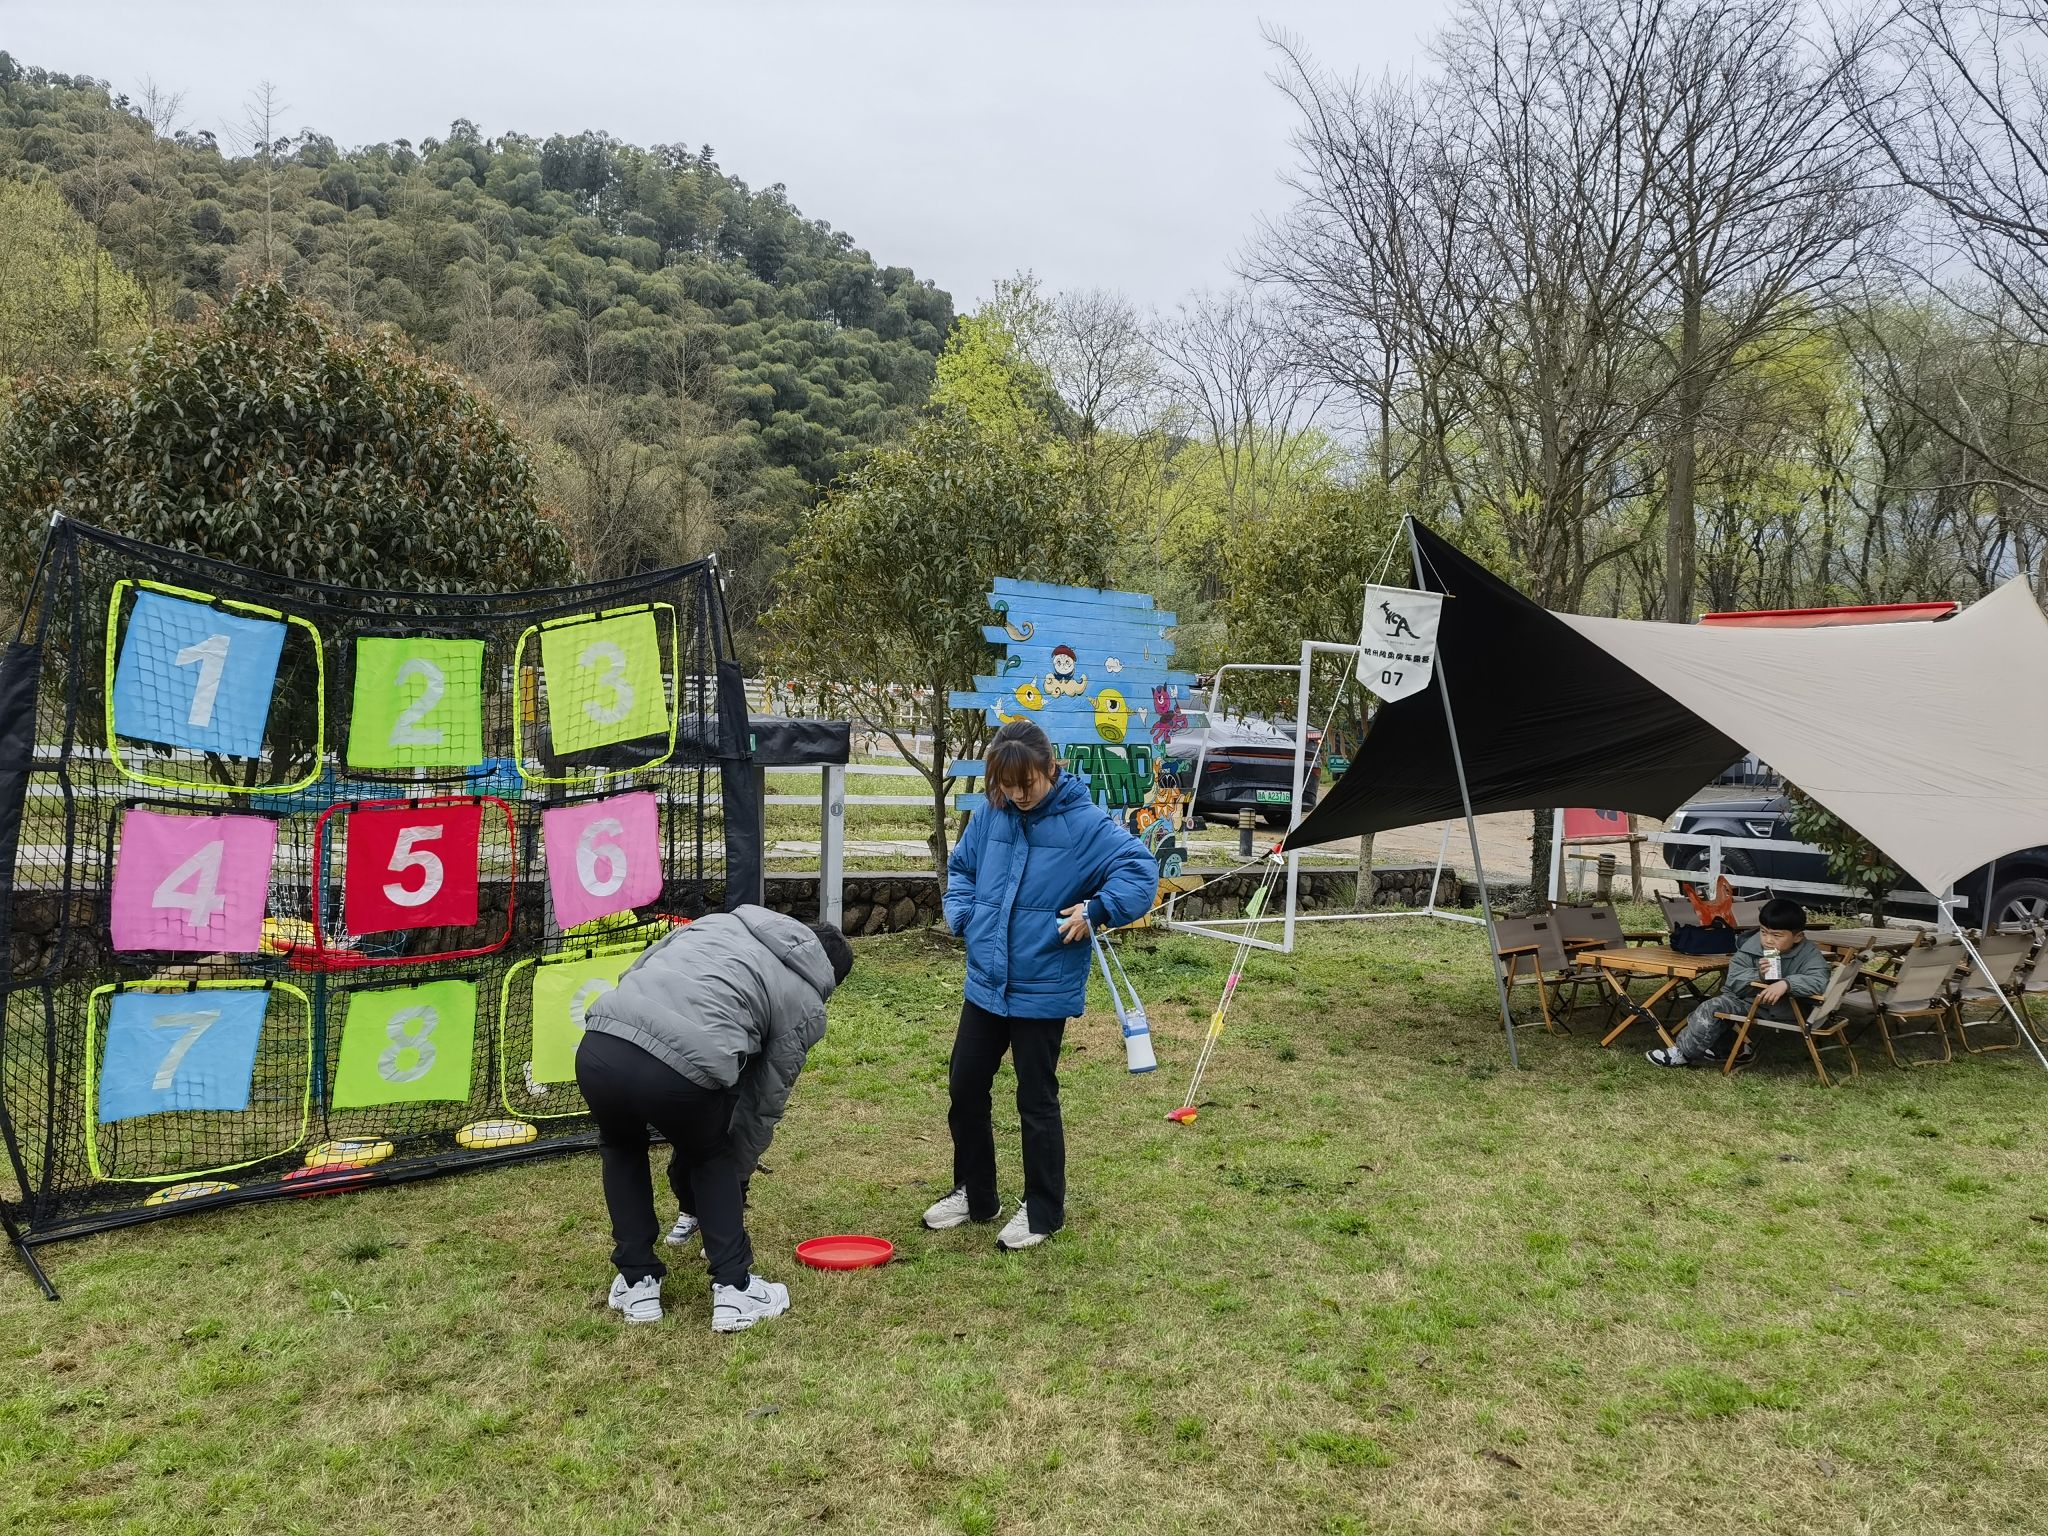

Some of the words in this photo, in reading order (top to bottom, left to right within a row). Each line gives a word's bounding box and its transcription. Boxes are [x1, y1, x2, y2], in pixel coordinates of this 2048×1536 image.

[174, 633, 232, 727] 1
[389, 658, 445, 746] 2
[577, 641, 635, 725] 3
[1381, 670, 1404, 686] 07
[150, 839, 226, 927] 4
[382, 824, 445, 907] 5
[575, 817, 628, 897] 6
[151, 1009, 222, 1091] 7
[376, 1004, 439, 1084] 8
